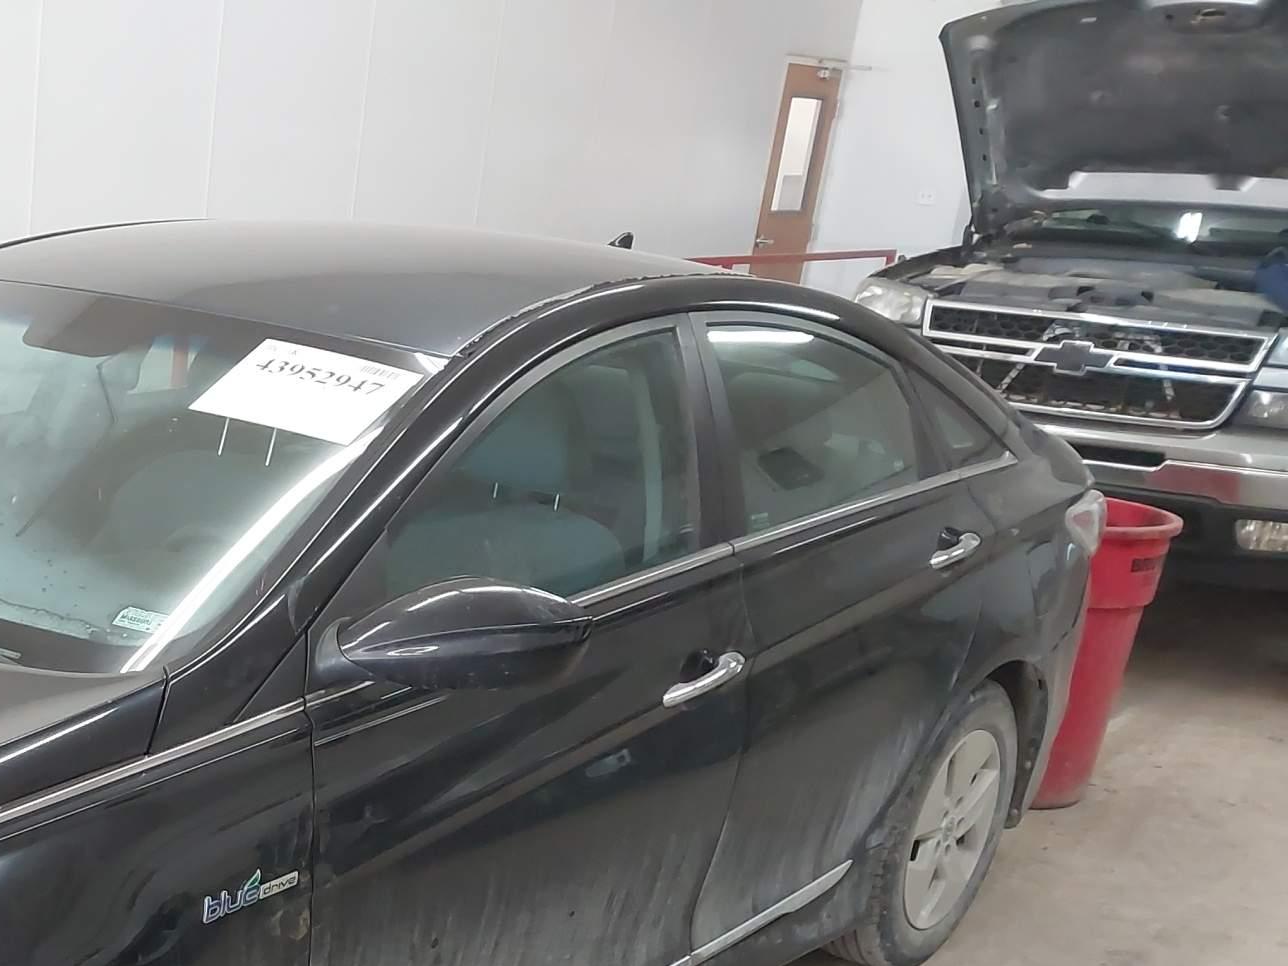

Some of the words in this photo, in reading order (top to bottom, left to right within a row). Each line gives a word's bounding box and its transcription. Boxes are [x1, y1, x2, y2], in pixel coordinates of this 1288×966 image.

[256, 358, 385, 395] 43952947
[203, 869, 261, 924] blue
[262, 876, 297, 896] drive
